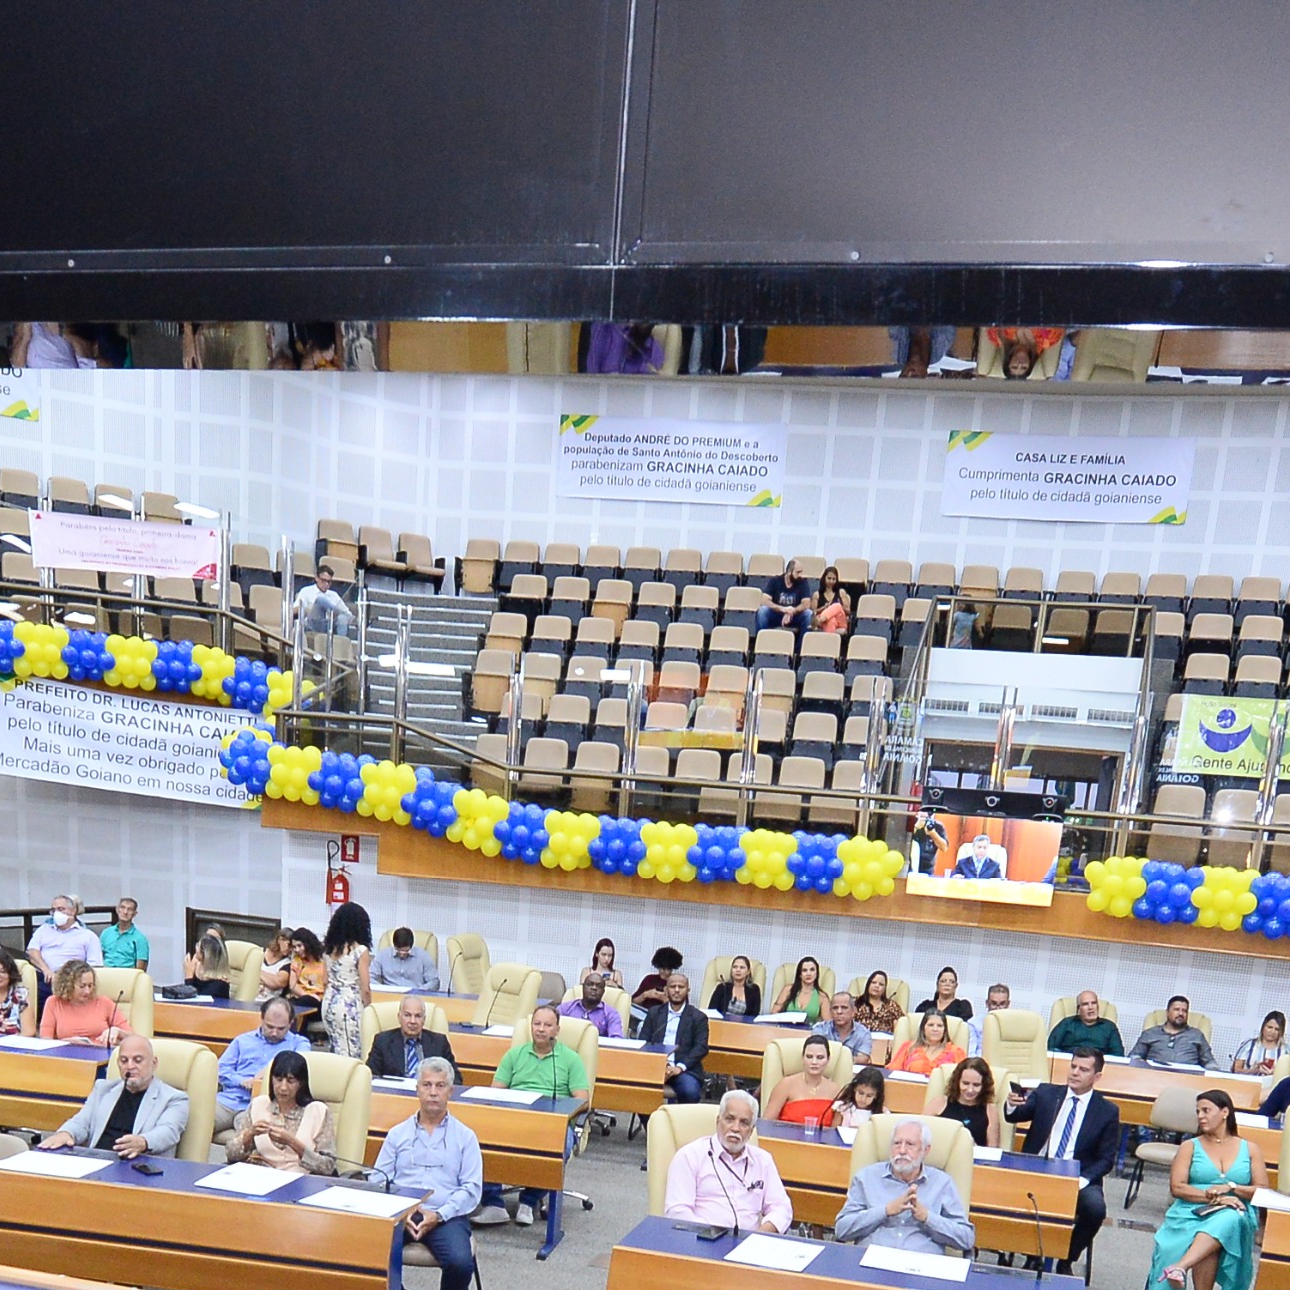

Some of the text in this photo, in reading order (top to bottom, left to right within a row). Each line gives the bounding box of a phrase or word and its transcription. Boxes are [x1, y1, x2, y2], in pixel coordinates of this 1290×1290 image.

[584, 432, 759, 449] Deputado ANDRÉ DO PREMIUM e a
[563, 445, 779, 463] população de Santo Antônio do Descoberto
[1015, 452, 1125, 465] CASA LIZ E FAMÍLIA
[571, 459, 769, 477] parabenizam GRACINHA CAIADO
[959, 467, 1177, 487] Cumprimenta GRACINHA CAIADO
[579, 474, 603, 487] pelo
[637, 476, 651, 488] de
[655, 477, 691, 489] cidadã
[695, 480, 757, 492] goianiense
[970, 488, 1162, 506] pelo título de cidadã goianiense
[15, 679, 88, 702] PREFEITO
[92, 692, 117, 708] DR.
[121, 698, 170, 716] LUCAS
[4, 693, 95, 721] Parabeniza
[101, 710, 195, 737] GRACINHA
[8, 716, 42, 733] pelo
[48, 720, 87, 740] título
[91, 728, 111, 744] de
[116, 732, 167, 752] cidadã
[24, 735, 62, 754] Mais
[67, 746, 101, 761] uma
[106, 751, 133, 766] vez
[139, 752, 205, 778] obrigado
[75, 765, 133, 786] Goiano
[137, 774, 161, 789] em
[166, 780, 211, 796] nossa
